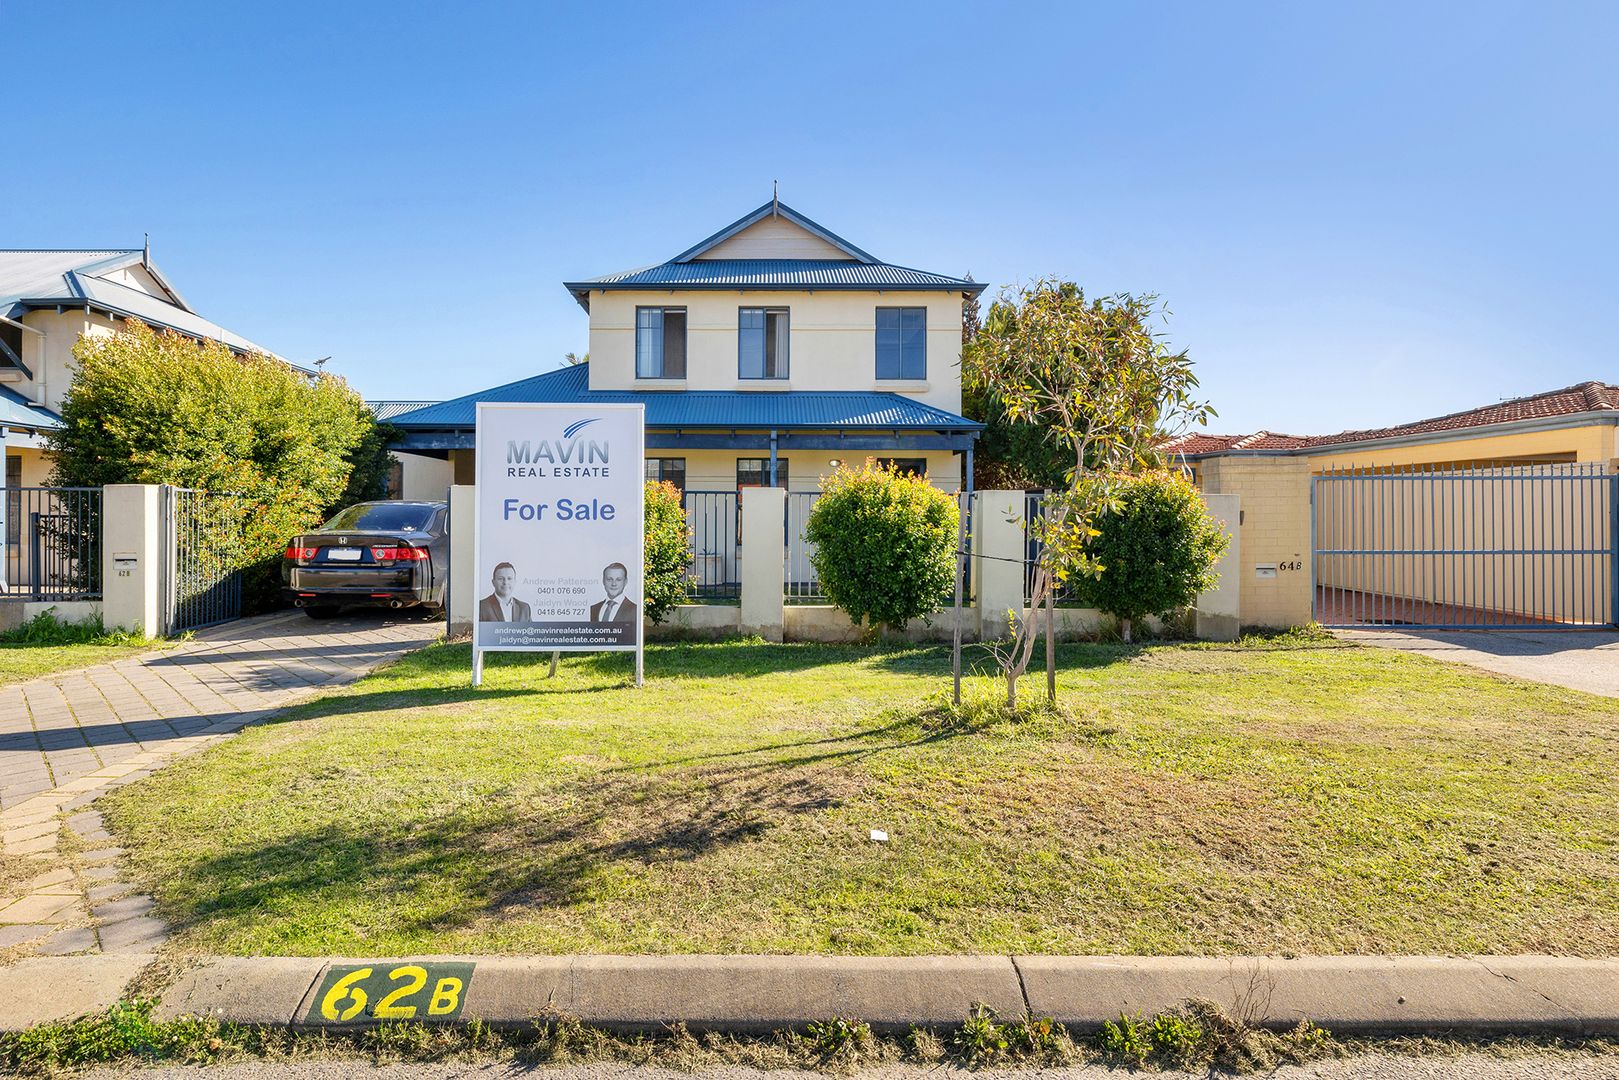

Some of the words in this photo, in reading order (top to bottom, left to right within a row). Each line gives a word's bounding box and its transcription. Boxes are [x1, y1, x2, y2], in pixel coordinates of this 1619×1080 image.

[506, 439, 610, 464] MAVIN
[507, 467, 546, 477] REAL
[553, 467, 610, 477] ESTATE
[503, 498, 549, 521] For
[556, 498, 616, 521] Sale
[522, 577, 556, 585] Andrew
[557, 577, 599, 585] Patterson
[537, 587, 555, 595] 0401
[557, 587, 571, 595] 076
[572, 587, 586, 595] 690
[533, 599, 562, 608] Jaidyn
[563, 599, 588, 607] Wood
[537, 608, 556, 616] 0418
[557, 608, 571, 616] 645
[572, 608, 586, 616] 727
[494, 627, 623, 635] andrewp@mavinrealestate.com.au
[499, 636, 618, 645] jaidyn@mavinrealestate.com.au
